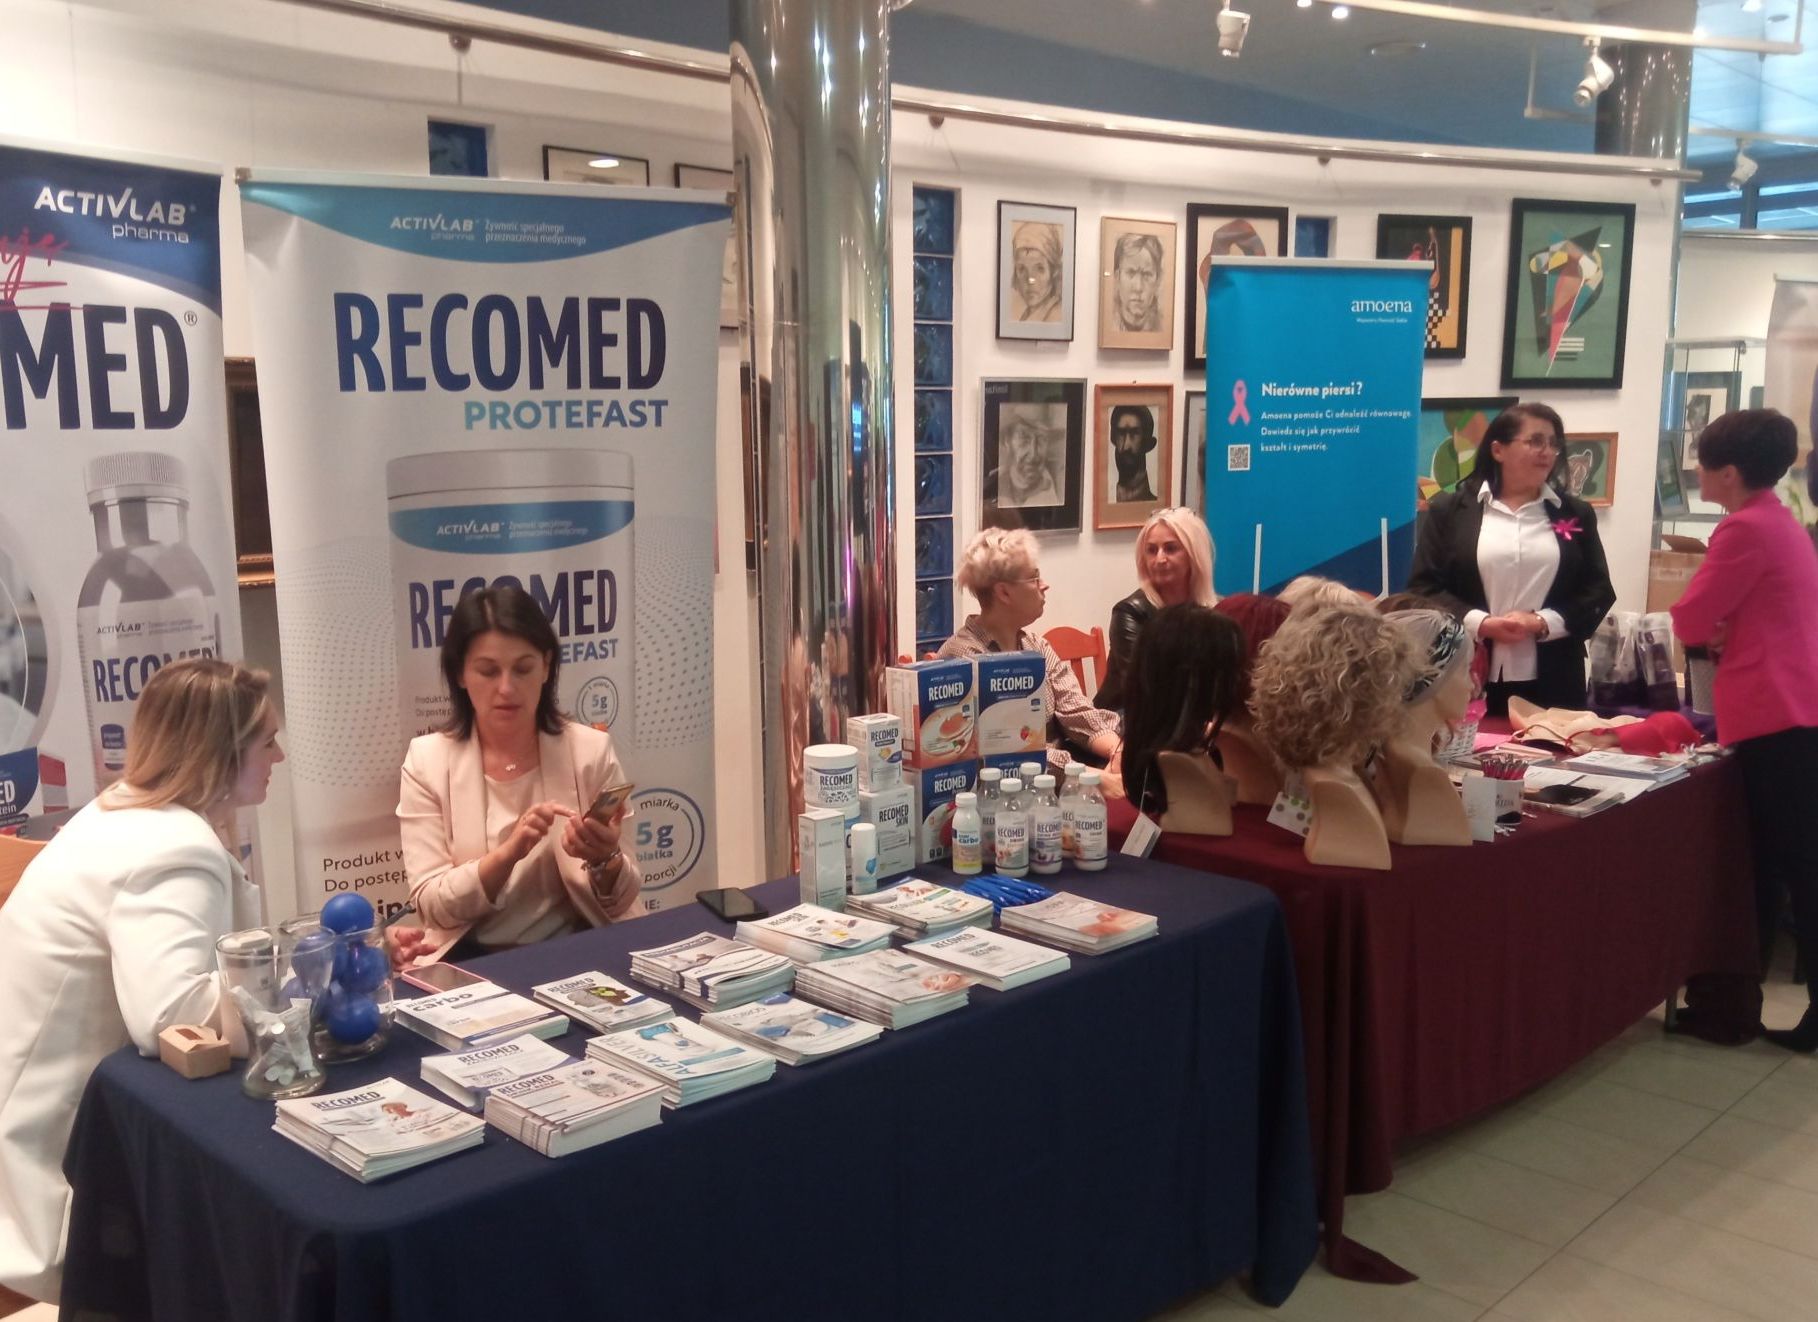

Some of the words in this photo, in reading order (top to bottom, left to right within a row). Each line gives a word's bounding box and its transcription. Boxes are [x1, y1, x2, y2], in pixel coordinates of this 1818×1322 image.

[34, 187, 186, 225] ACTIVLAB
[390, 214, 473, 231] ACTIVLAB
[112, 223, 190, 244] pharma
[1351, 300, 1412, 313] amoena
[333, 292, 666, 392] RECOMED
[1261, 383, 1319, 397] Nierówne
[1322, 381, 1362, 399] piersi?
[464, 399, 668, 431] PROTEFAST
[1261, 412, 1292, 420] Amoena
[1325, 409, 1334, 418] Ci
[1261, 427, 1293, 436] Dowiedz
[1307, 426, 1319, 437] jak
[409, 569, 617, 648] REMED
[928, 681, 965, 701] RECOMED
[990, 675, 1034, 692] RECOMED
[592, 694, 600, 708] 5
[870, 727, 899, 742] RECOMED
[820, 774, 853, 786] RECOMED
[934, 775, 967, 794] RECOMED
[640, 799, 680, 811] miarka
[879, 804, 909, 823] RECOMED
[636, 821, 653, 846] 5
[656, 824, 673, 848] g
[323, 850, 391, 872] Produkt
[644, 865, 677, 884] porcji
[325, 879, 349, 892] Do
[547, 977, 595, 993] RECOMED
[413, 994, 473, 1011] carbo
[458, 1044, 521, 1063] RECOMED
[497, 1074, 555, 1095] RECOMED
[311, 1091, 381, 1110] RECOMED
